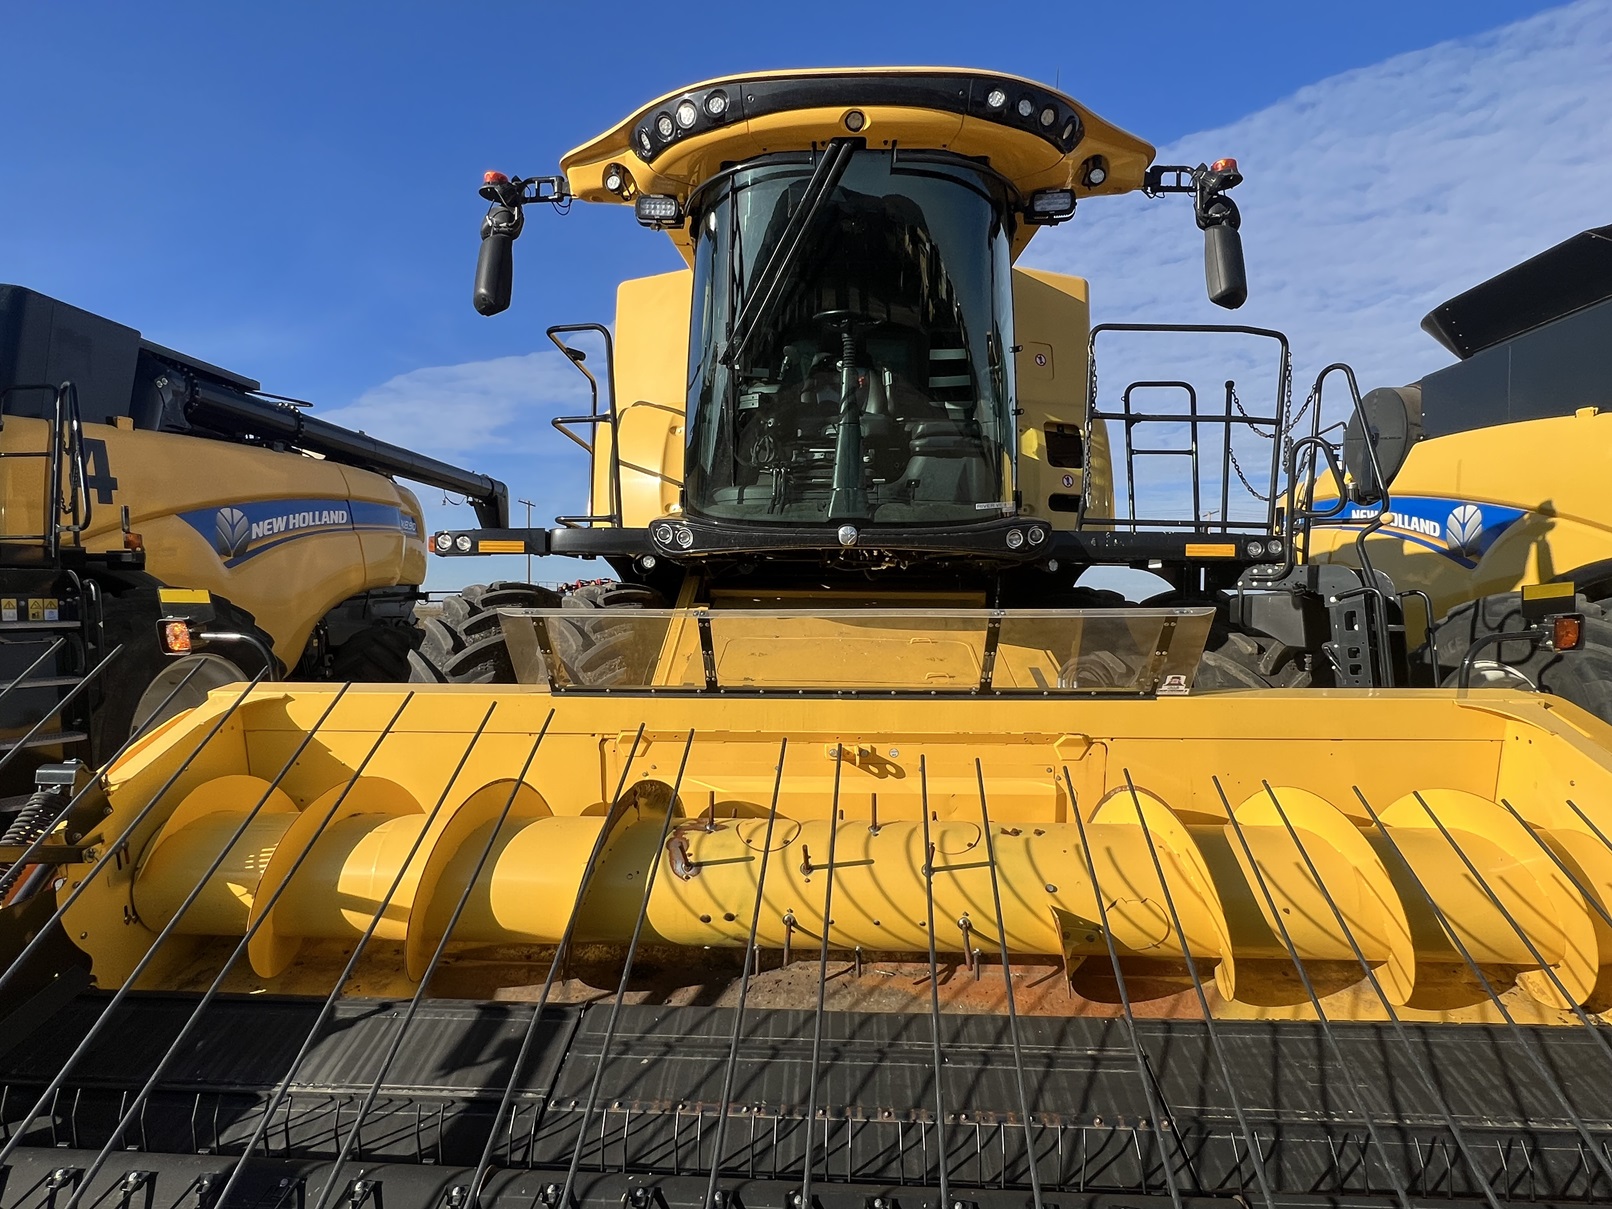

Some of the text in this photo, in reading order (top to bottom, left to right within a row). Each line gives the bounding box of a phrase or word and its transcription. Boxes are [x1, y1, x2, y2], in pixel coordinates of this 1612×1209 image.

[77, 437, 119, 505] 4
[251, 510, 348, 540] NEW HOLLAND
[1390, 512, 1440, 537] OLLAND
